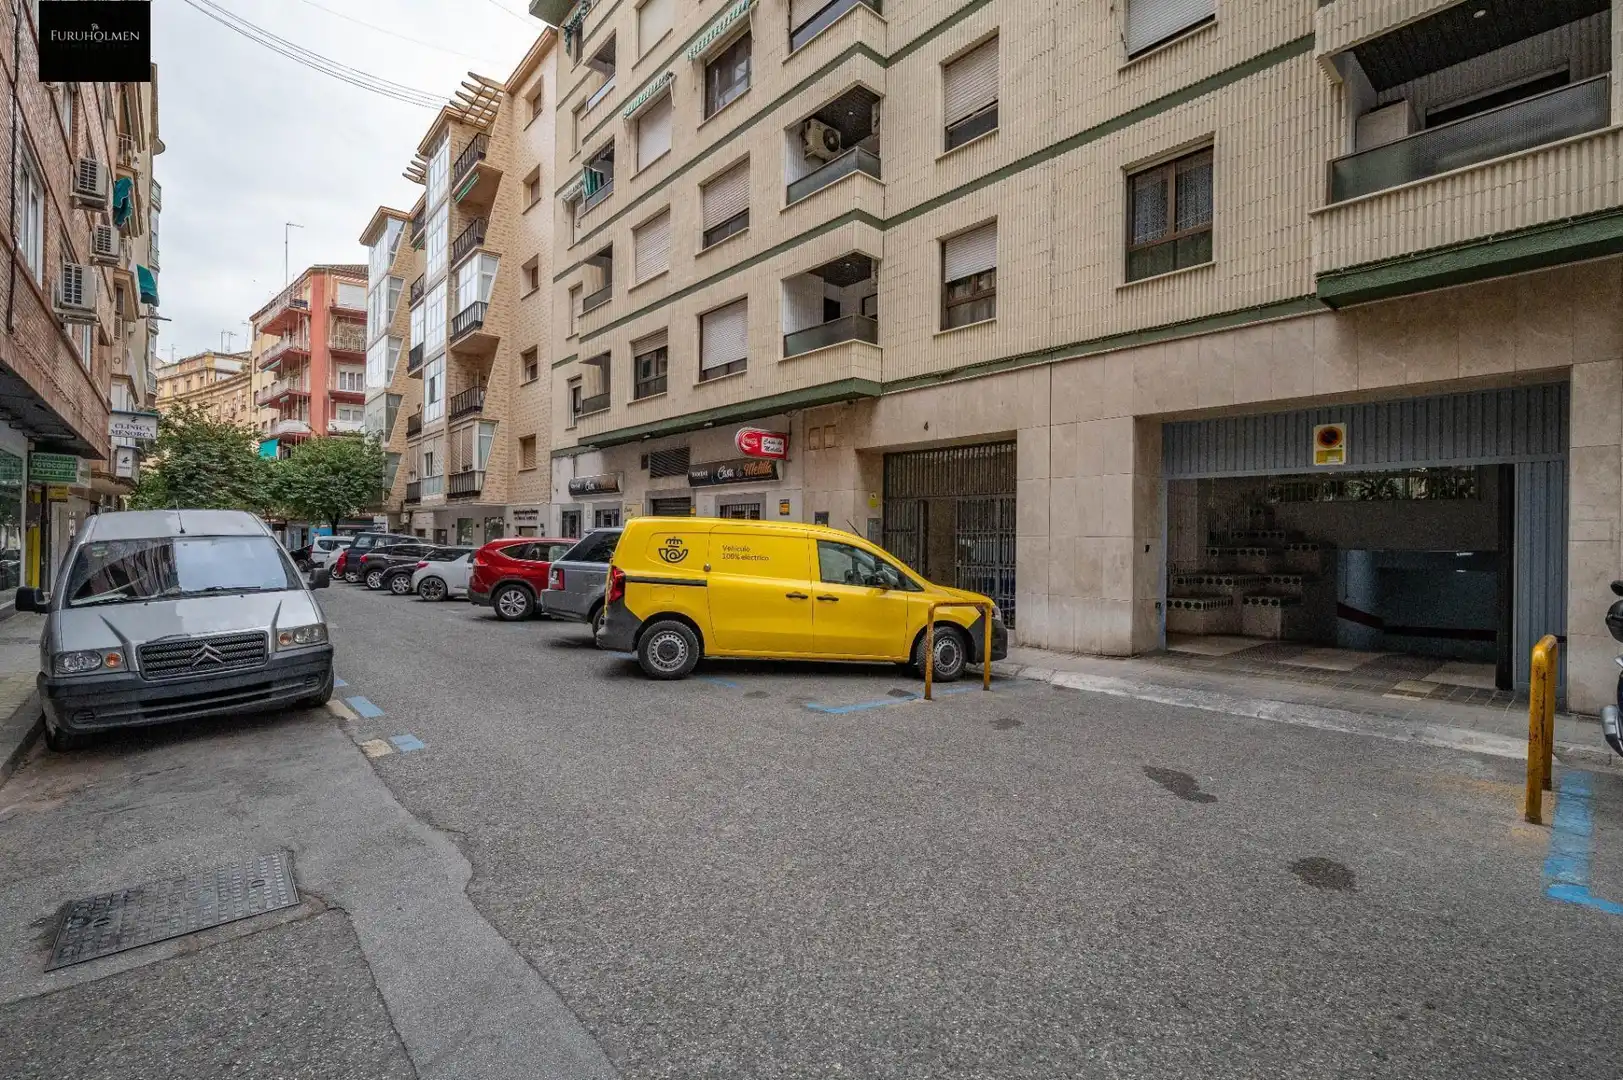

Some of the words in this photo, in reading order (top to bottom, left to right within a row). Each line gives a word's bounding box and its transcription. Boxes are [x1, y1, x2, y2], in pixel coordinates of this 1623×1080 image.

[110, 429, 154, 438] MENORCA
[717, 465, 735, 479] Casa
[744, 460, 772, 476] Melilla
[722, 552, 740, 560] 100%
